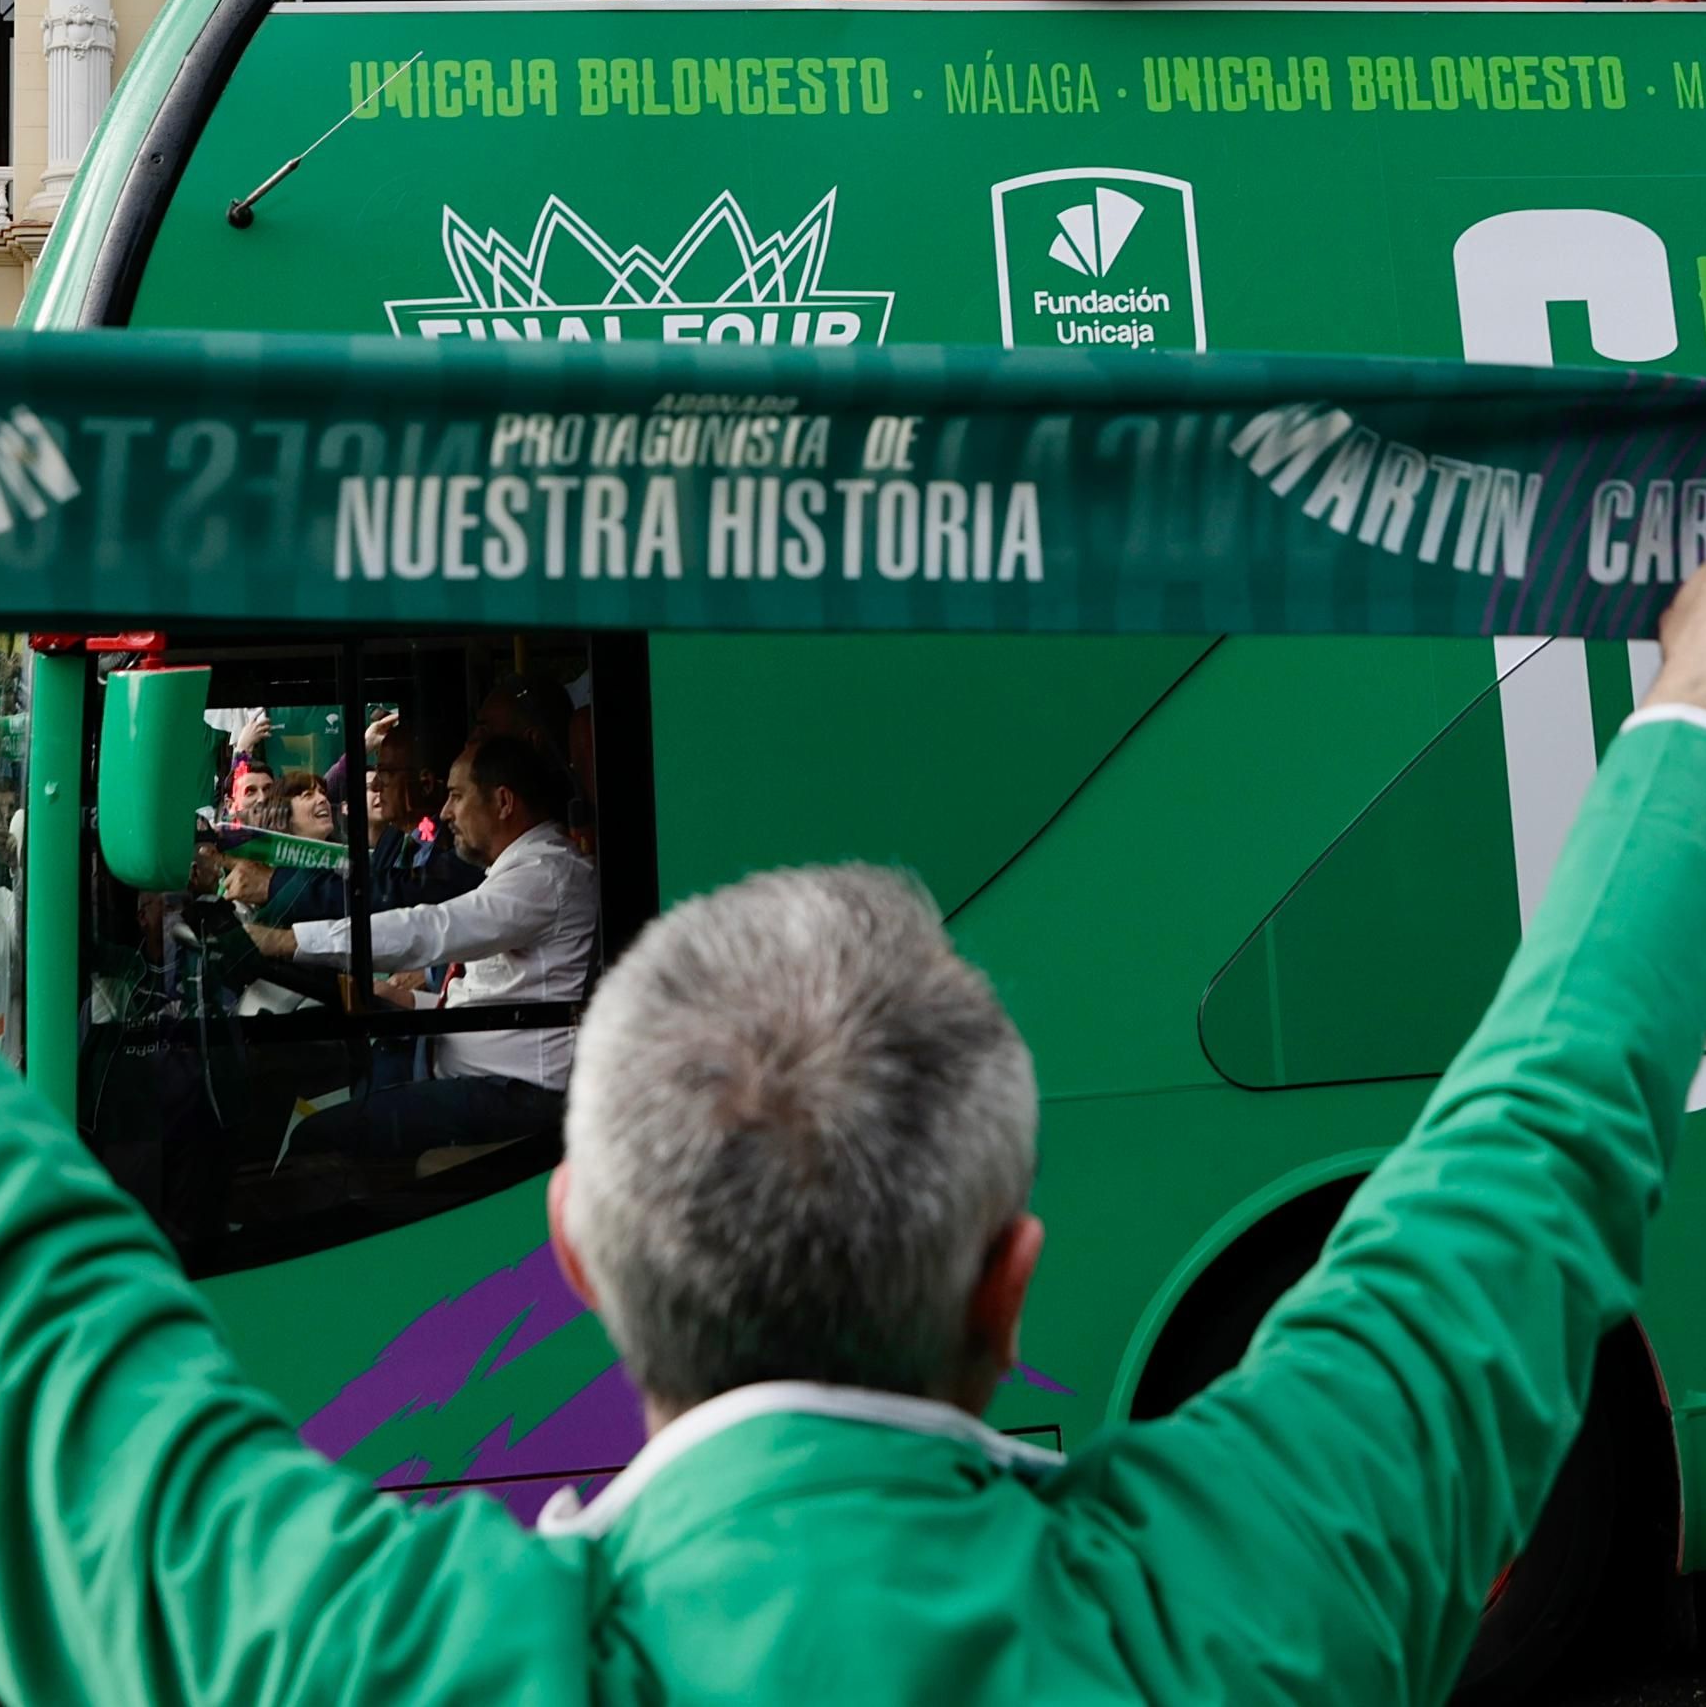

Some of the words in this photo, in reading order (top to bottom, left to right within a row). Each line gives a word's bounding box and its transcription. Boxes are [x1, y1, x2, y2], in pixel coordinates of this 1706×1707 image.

[349, 59, 558, 120] UNICAJA
[578, 56, 889, 117] BALONCESTO
[944, 50, 1100, 115] MÁLAGA
[1143, 56, 1330, 113] UNICAJA
[1348, 55, 1627, 111] BALONCESTO
[1034, 286, 1170, 315] Fundación
[1056, 318, 1155, 350] Unicaja
[490, 413, 832, 469] PROTAGONISTA
[860, 414, 925, 471] DE
[1228, 399, 1542, 581] MARTIN
[334, 475, 684, 581] NUESTRA
[706, 478, 1044, 582] HISTORIA
